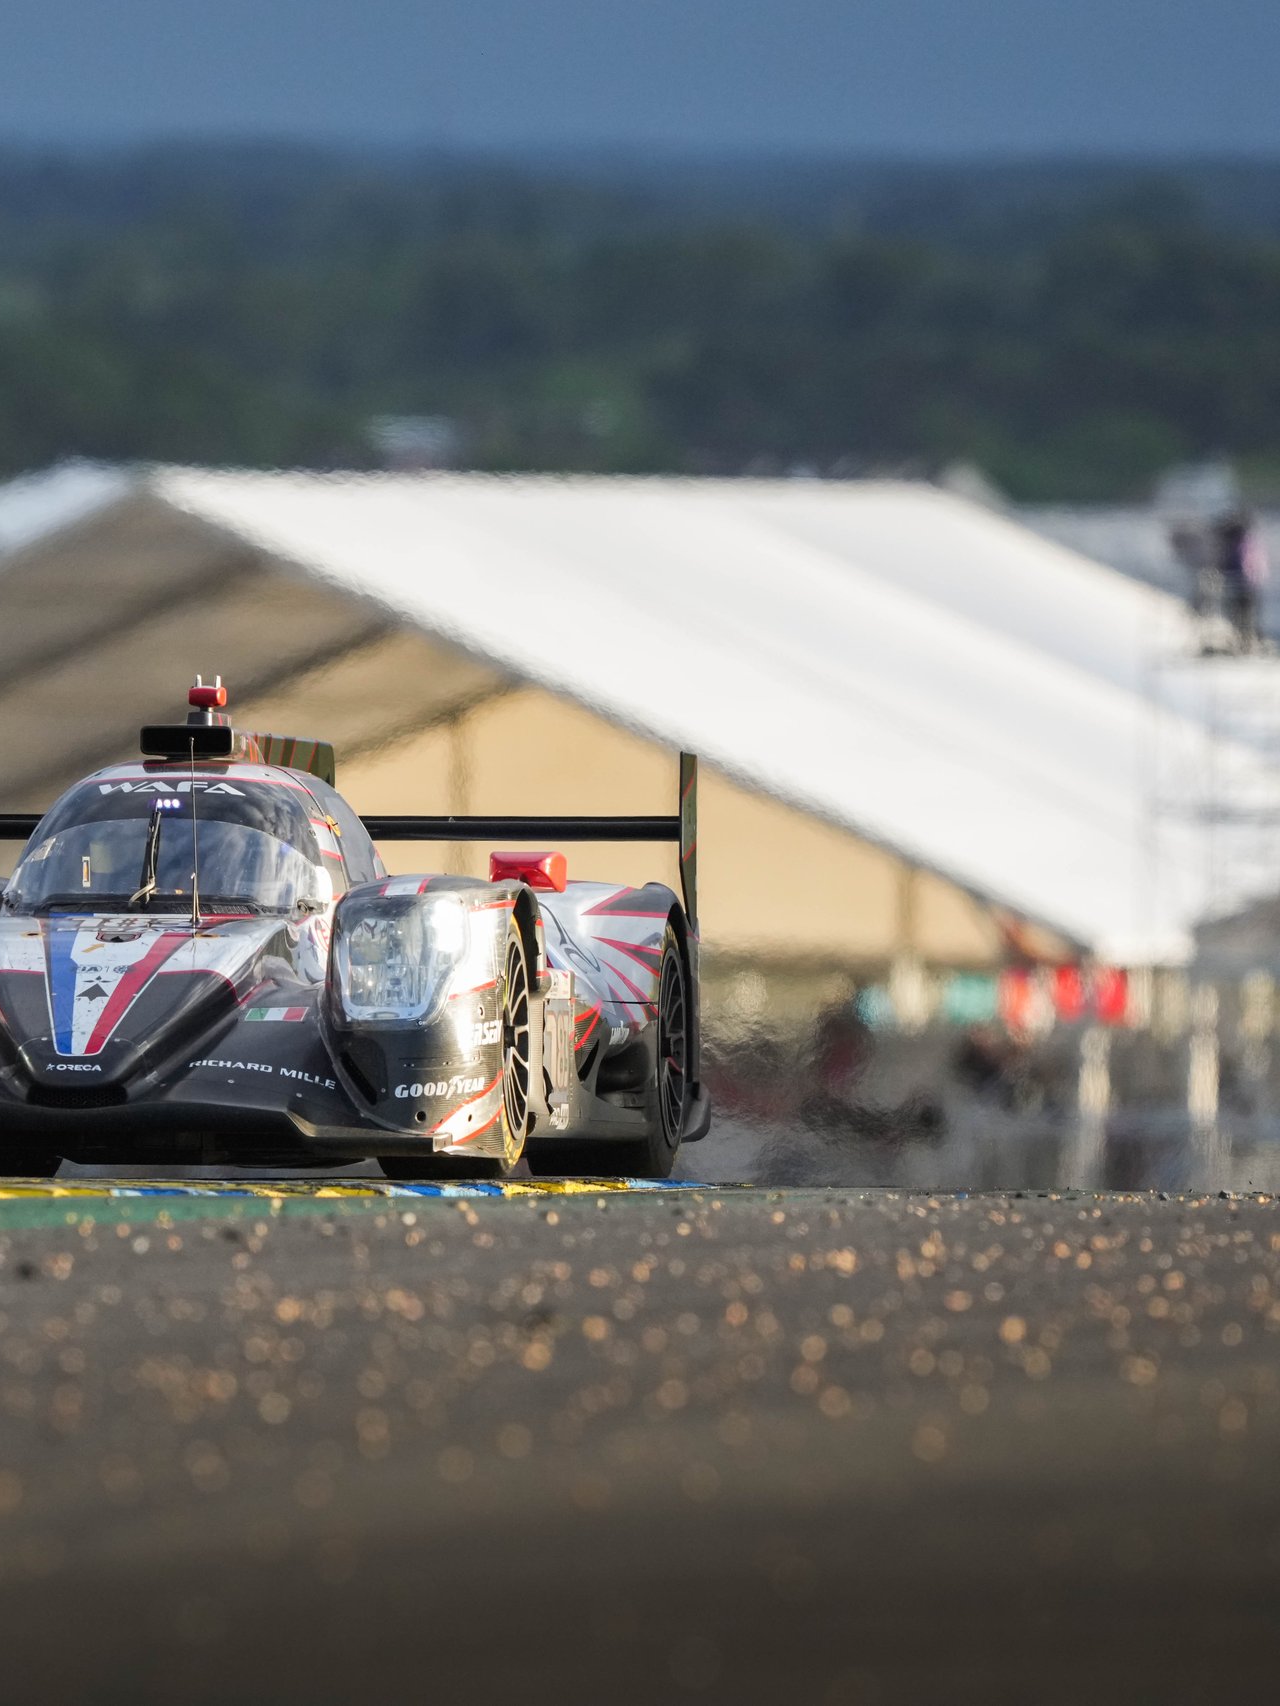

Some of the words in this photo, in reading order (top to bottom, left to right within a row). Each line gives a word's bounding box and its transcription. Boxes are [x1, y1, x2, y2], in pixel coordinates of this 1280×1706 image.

[98, 781, 246, 796] WAFA
[56, 1063, 102, 1072] ORECA
[189, 1059, 272, 1073] RICHARD
[280, 1067, 337, 1090] MILLE
[394, 1075, 486, 1100] GOODYEAR
